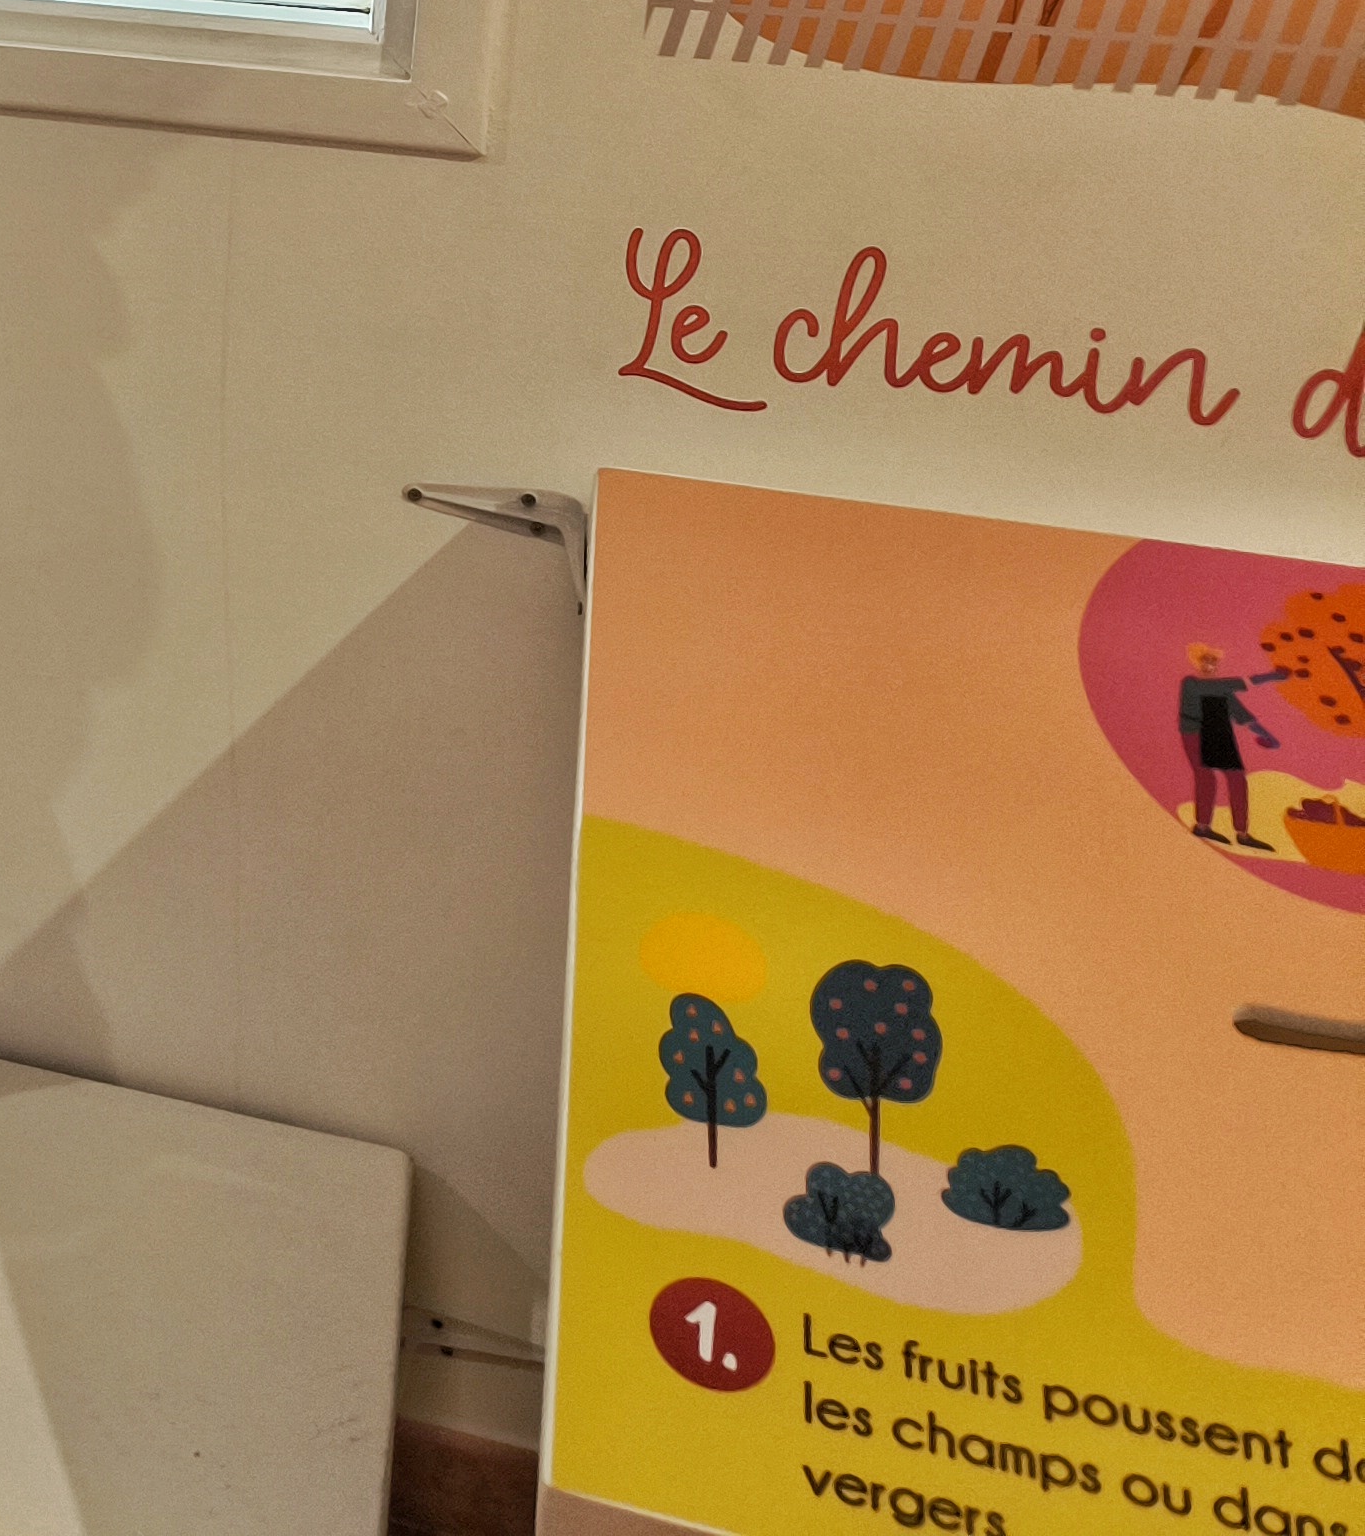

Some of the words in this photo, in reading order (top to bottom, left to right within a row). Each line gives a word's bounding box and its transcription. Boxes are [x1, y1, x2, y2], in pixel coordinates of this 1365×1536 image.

[618, 227, 768, 413] Le
[773, 246, 1242, 427] chemin
[684, 1300, 738, 1372] 1.
[802, 1312, 885, 1372] Les
[901, 1339, 1024, 1405] fruits
[1042, 1383, 1293, 1470] poussent
[1312, 1438, 1365, 1484] d
[803, 1380, 874, 1438] les
[891, 1410, 1103, 1496] champs
[1121, 1472, 1193, 1518] ou
